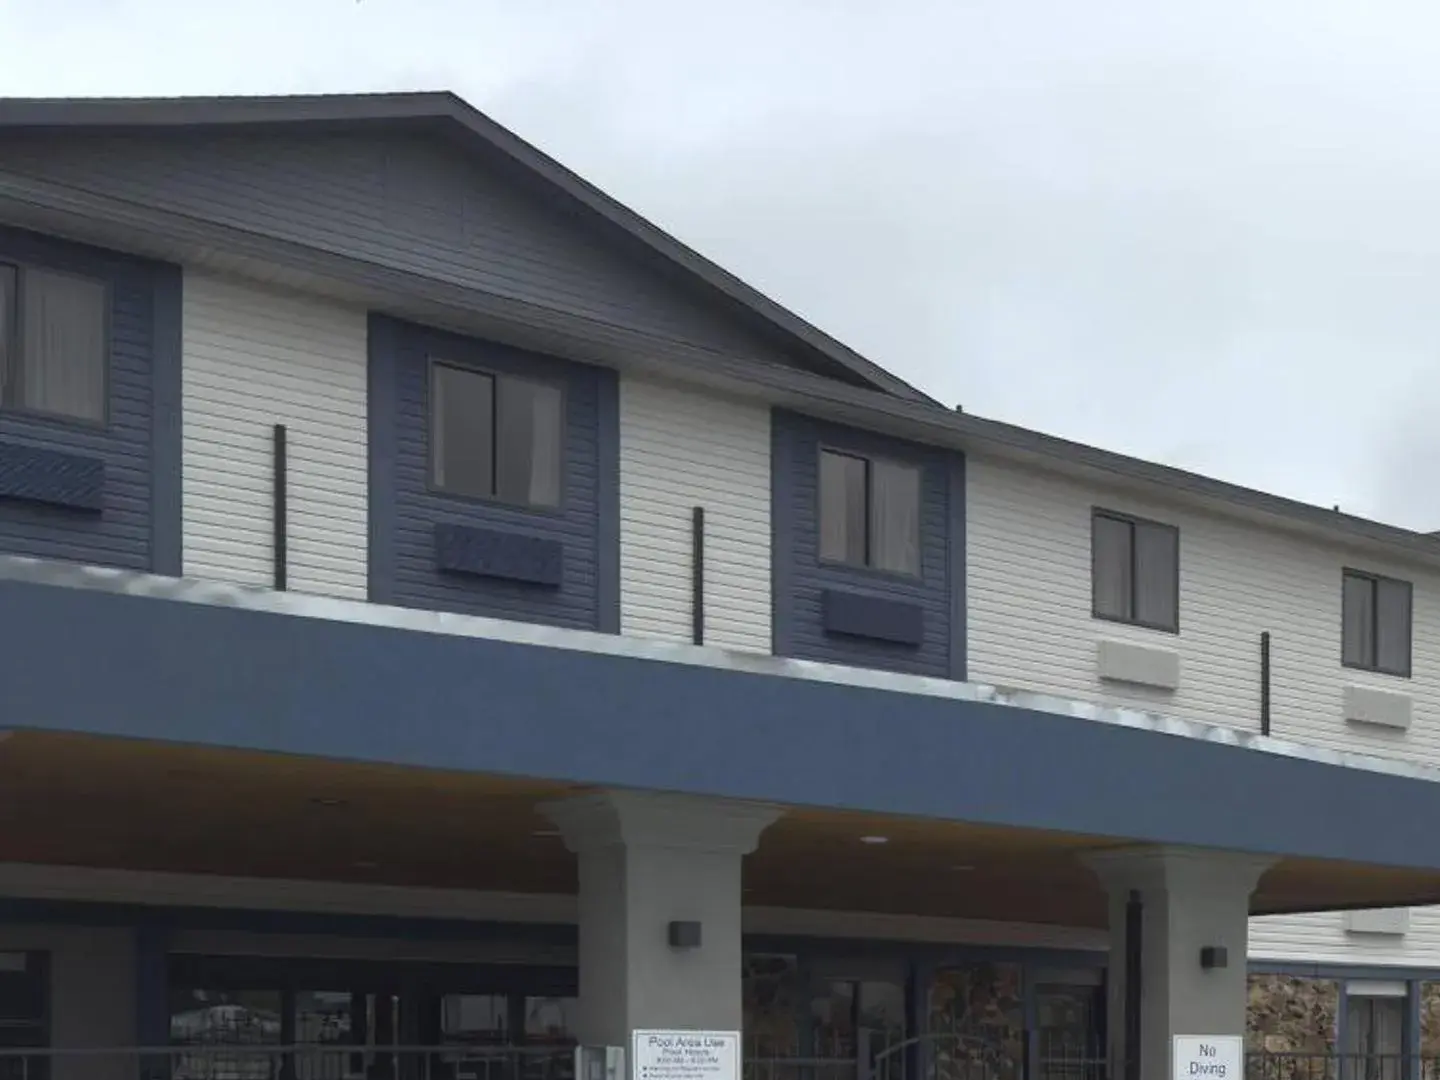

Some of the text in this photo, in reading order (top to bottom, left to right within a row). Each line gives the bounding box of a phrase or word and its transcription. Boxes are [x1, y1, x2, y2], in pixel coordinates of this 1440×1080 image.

[648, 1036, 674, 1047] Pool
[676, 1037, 702, 1047] Area
[1199, 1044, 1217, 1057] No
[1190, 1061, 1226, 1078] Diving
